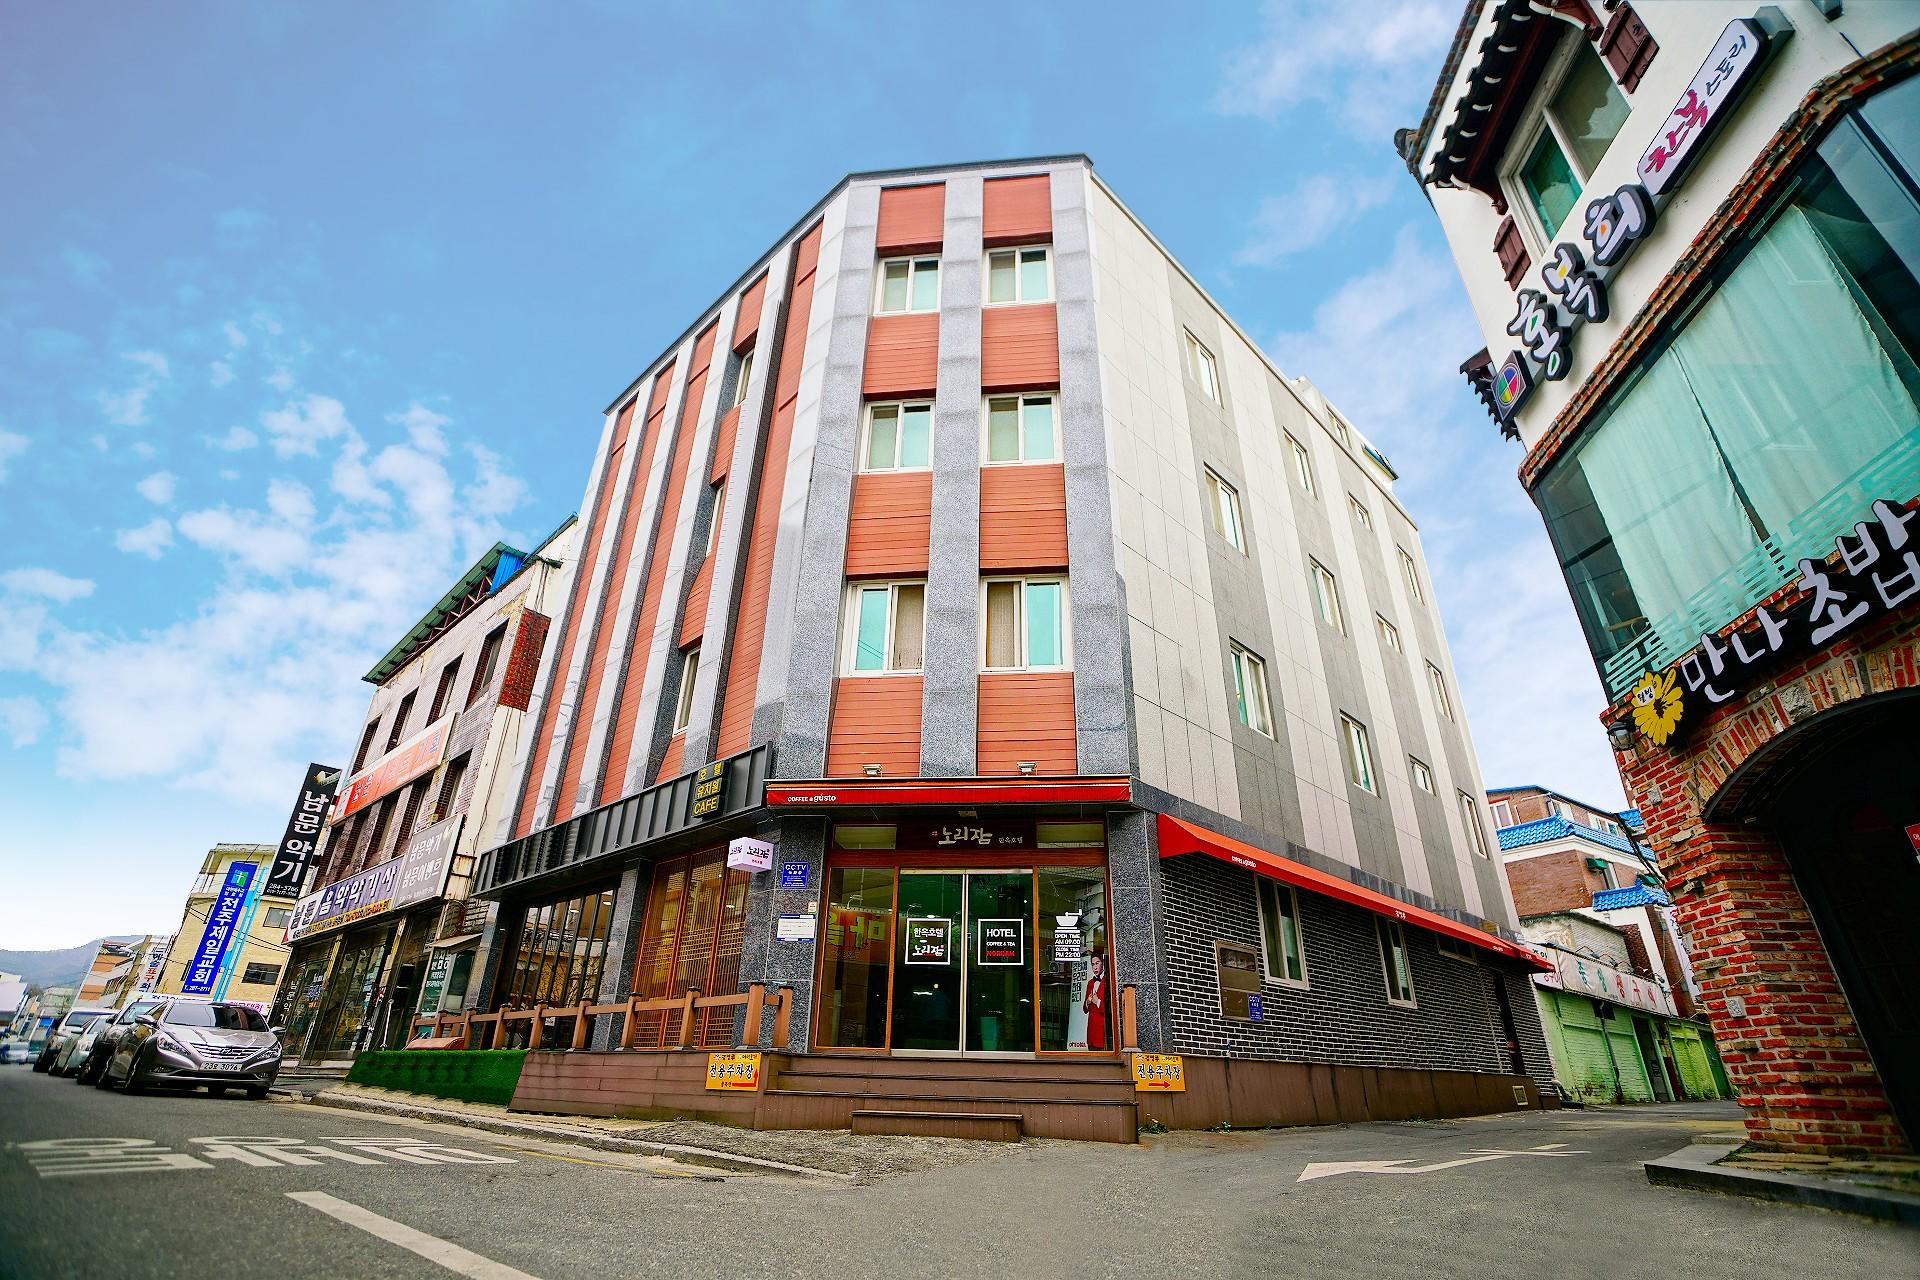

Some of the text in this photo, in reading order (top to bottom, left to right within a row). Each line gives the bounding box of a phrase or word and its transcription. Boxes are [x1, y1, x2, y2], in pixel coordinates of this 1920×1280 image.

[1706, 34, 1748, 98] 스토리
[1509, 189, 1648, 378] 홍복희
[693, 796, 718, 815] CAFE
[191, 896, 241, 985] 전주제일교회
[986, 928, 1017, 938] HOTEL
[709, 1062, 754, 1080] 전용주차장
[1137, 1063, 1181, 1081] 전용주차장
